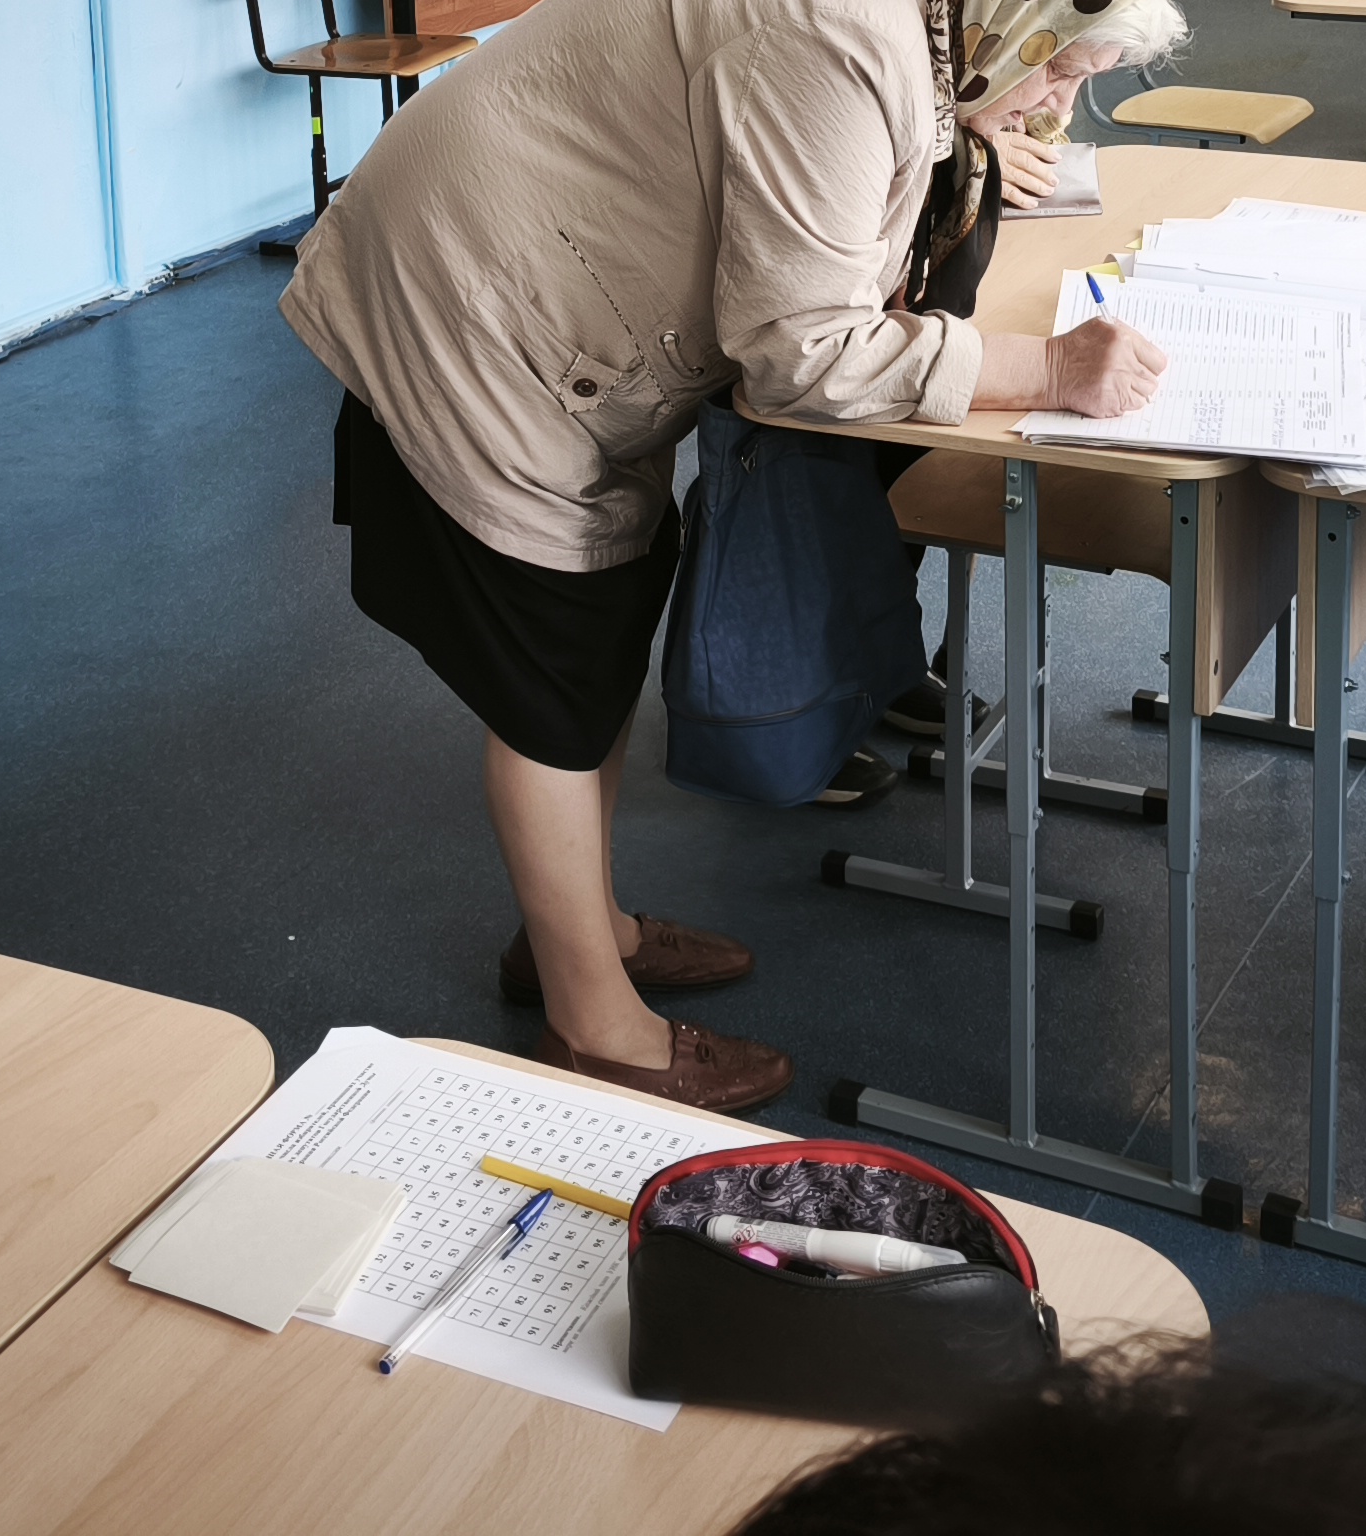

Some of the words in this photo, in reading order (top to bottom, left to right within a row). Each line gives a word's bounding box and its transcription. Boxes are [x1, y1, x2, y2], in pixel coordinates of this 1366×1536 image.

[393, 1157, 405, 1165] 16
[410, 1136, 421, 1146] 17
[427, 1118, 439, 1127] 18
[443, 1100, 454, 1109] 19
[459, 1083, 471, 1092] 20
[403, 1183, 414, 1193] 25
[419, 1164, 431, 1174] 26
[435, 1143, 447, 1154] 27
[452, 1125, 465, 1134] 28
[468, 1107, 480, 1116] 29
[484, 1089, 496, 1099] 30
[434, 1076, 445, 1085] 10
[558, 1154, 570, 1164] 68
[574, 1136, 584, 1145] 69
[588, 1117, 600, 1126] 70
[386, 1282, 398, 1292] 41
[403, 1261, 415, 1272] 42
[421, 1239, 433, 1250] 43
[439, 1219, 450, 1228] 44
[456, 1198, 467, 1209] 45
[473, 1179, 484, 1188] 46
[506, 1139, 517, 1148] 48
[521, 1121, 531, 1130] 49
[536, 1103, 547, 1113] 50
[393, 1232, 405, 1243] 33
[411, 1211, 423, 1222] 34
[428, 1190, 440, 1201] 35
[445, 1172, 458, 1181] 36
[462, 1151, 473, 1162] 37
[478, 1132, 491, 1142] 38
[494, 1114, 505, 1124] 39
[511, 1096, 522, 1106] 40
[413, 1290, 426, 1301] 51
[430, 1269, 443, 1280] 52
[448, 1248, 460, 1259] 53
[465, 1227, 478, 1238] 54
[482, 1206, 495, 1217] 55
[499, 1186, 511, 1197] 56
[531, 1146, 543, 1156] 58
[547, 1128, 558, 1138] 59
[562, 1110, 573, 1120] 60
[470, 1308, 483, 1318] 71
[486, 1286, 499, 1296] 72
[503, 1264, 516, 1274] 73
[521, 1243, 534, 1253] 74
[537, 1221, 549, 1231] 75
[553, 1201, 566, 1211] 76
[584, 1162, 597, 1170] 78
[599, 1143, 611, 1152] 79
[614, 1124, 626, 1134] 80
[498, 1317, 512, 1328] 81
[515, 1295, 528, 1306] 82
[532, 1273, 545, 1284] 83
[548, 1251, 562, 1262] 84
[565, 1230, 577, 1241] 85
[581, 1210, 594, 1220] 86
[612, 1170, 624, 1179] 88
[627, 1150, 638, 1160] 89
[641, 1131, 653, 1140] 90
[527, 1326, 541, 1336] 91
[544, 1304, 557, 1314] 92
[561, 1281, 573, 1292] 93
[577, 1259, 590, 1270] 94
[593, 1238, 605, 1248] 95
[609, 1217, 623, 1228] 96
[654, 1158, 664, 1167] 99
[667, 1137, 681, 1150] 100
